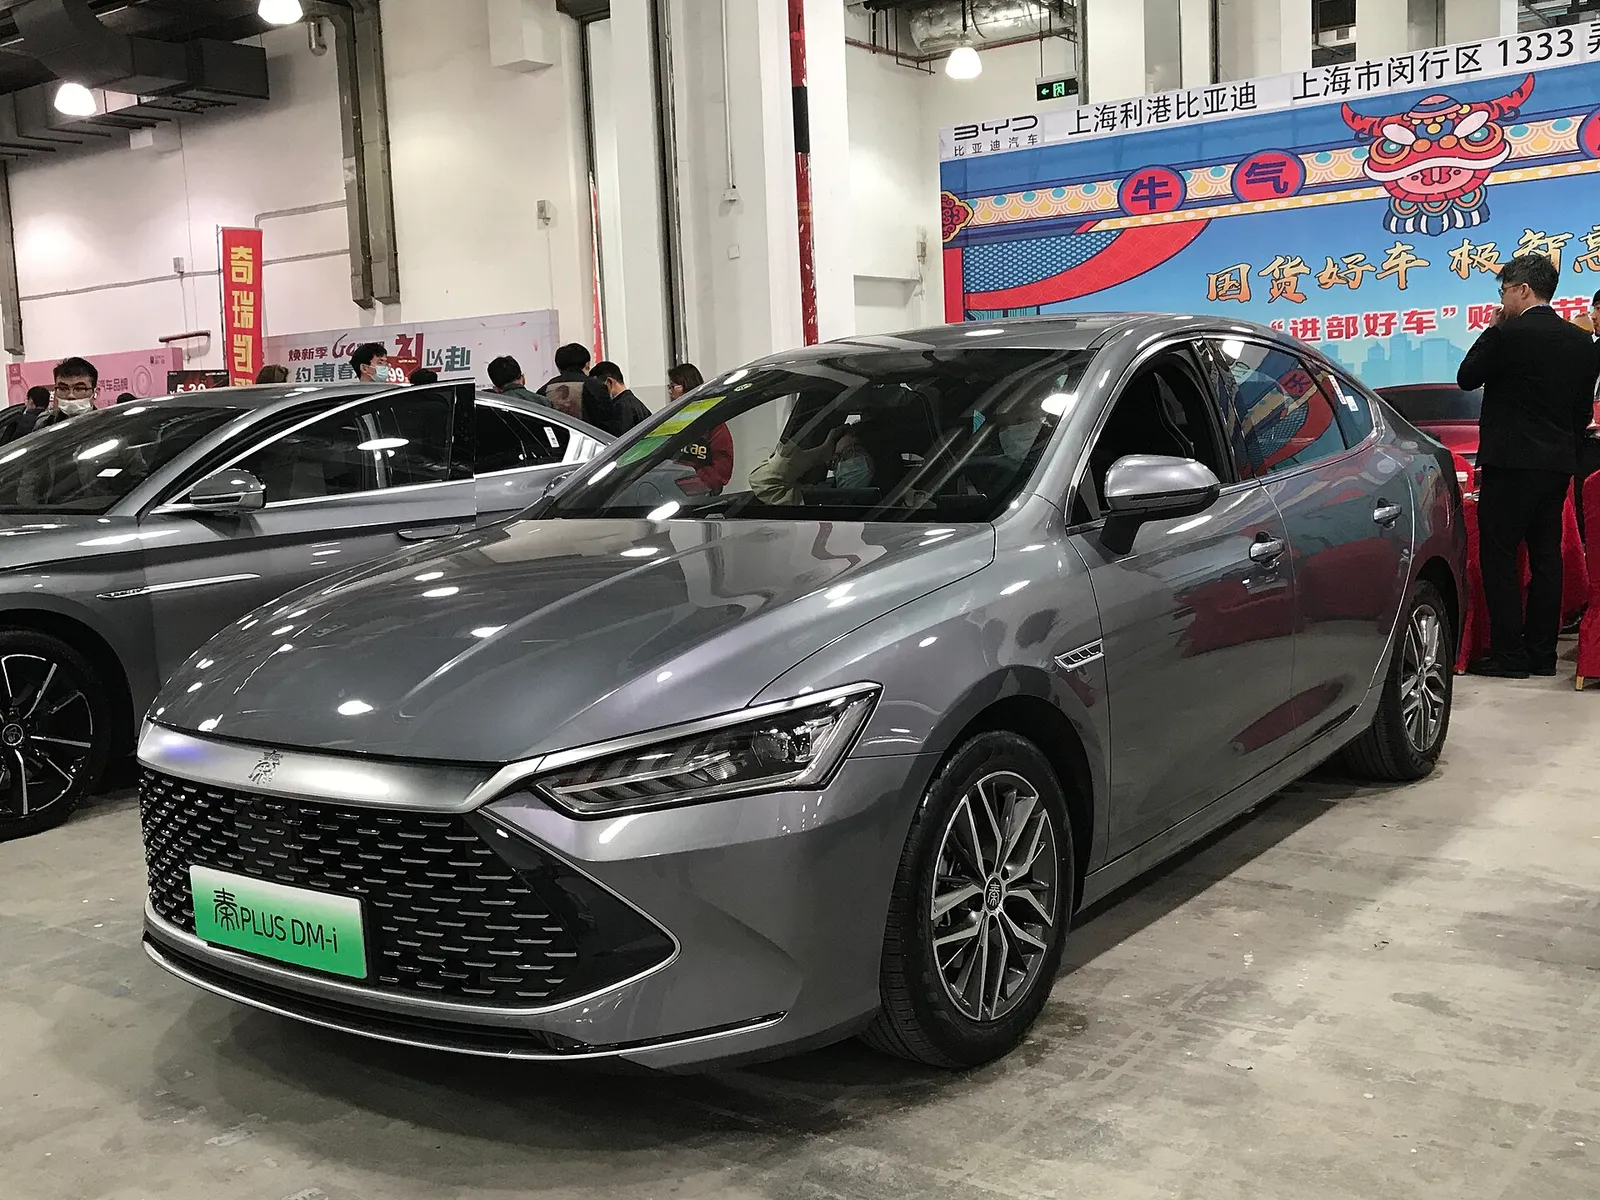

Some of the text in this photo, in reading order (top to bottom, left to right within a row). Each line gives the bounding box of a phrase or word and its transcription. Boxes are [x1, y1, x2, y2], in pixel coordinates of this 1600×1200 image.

[1293, 43, 1483, 101] 上海市闵行区
[1497, 28, 1575, 66] 1333
[953, 114, 1039, 141] BYD
[1068, 82, 1257, 136] 上海利港比亚迪
[953, 133, 1039, 157] 比亚迪汽车
[1131, 161, 1289, 210] 牛 气
[1206, 241, 1431, 304] 国货好车
[230, 245, 255, 387] 奇瑞凯
[212, 887, 338, 954] 秦PLUS DM-i
